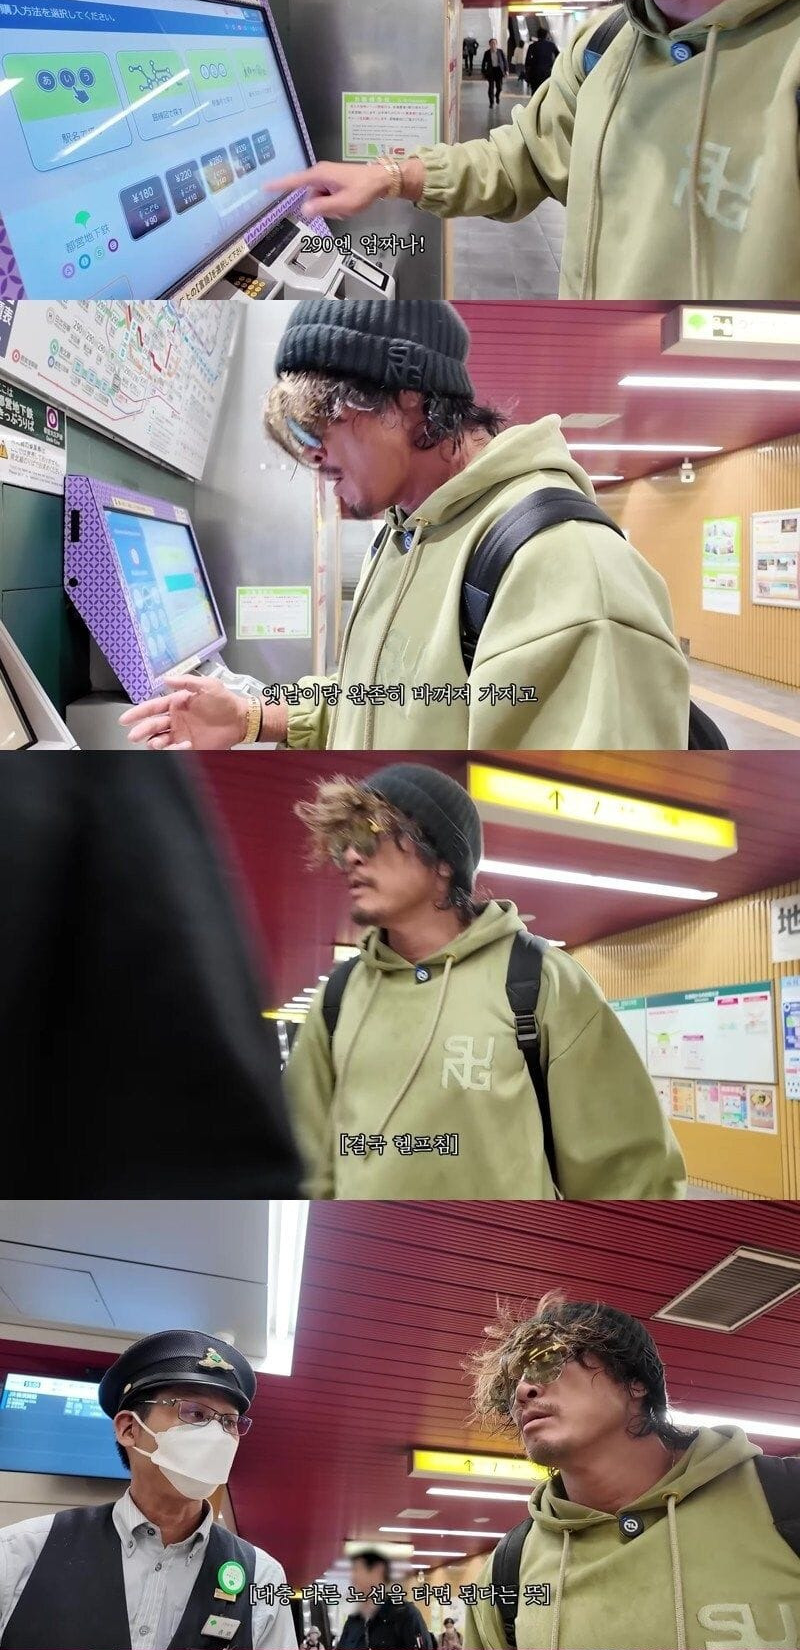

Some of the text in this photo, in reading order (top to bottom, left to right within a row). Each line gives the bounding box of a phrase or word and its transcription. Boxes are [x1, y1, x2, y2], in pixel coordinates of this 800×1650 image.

[175, 169, 192, 183] ¥220
[131, 187, 154, 204] ¥180
[65, 224, 112, 255] 都営地下鉄
